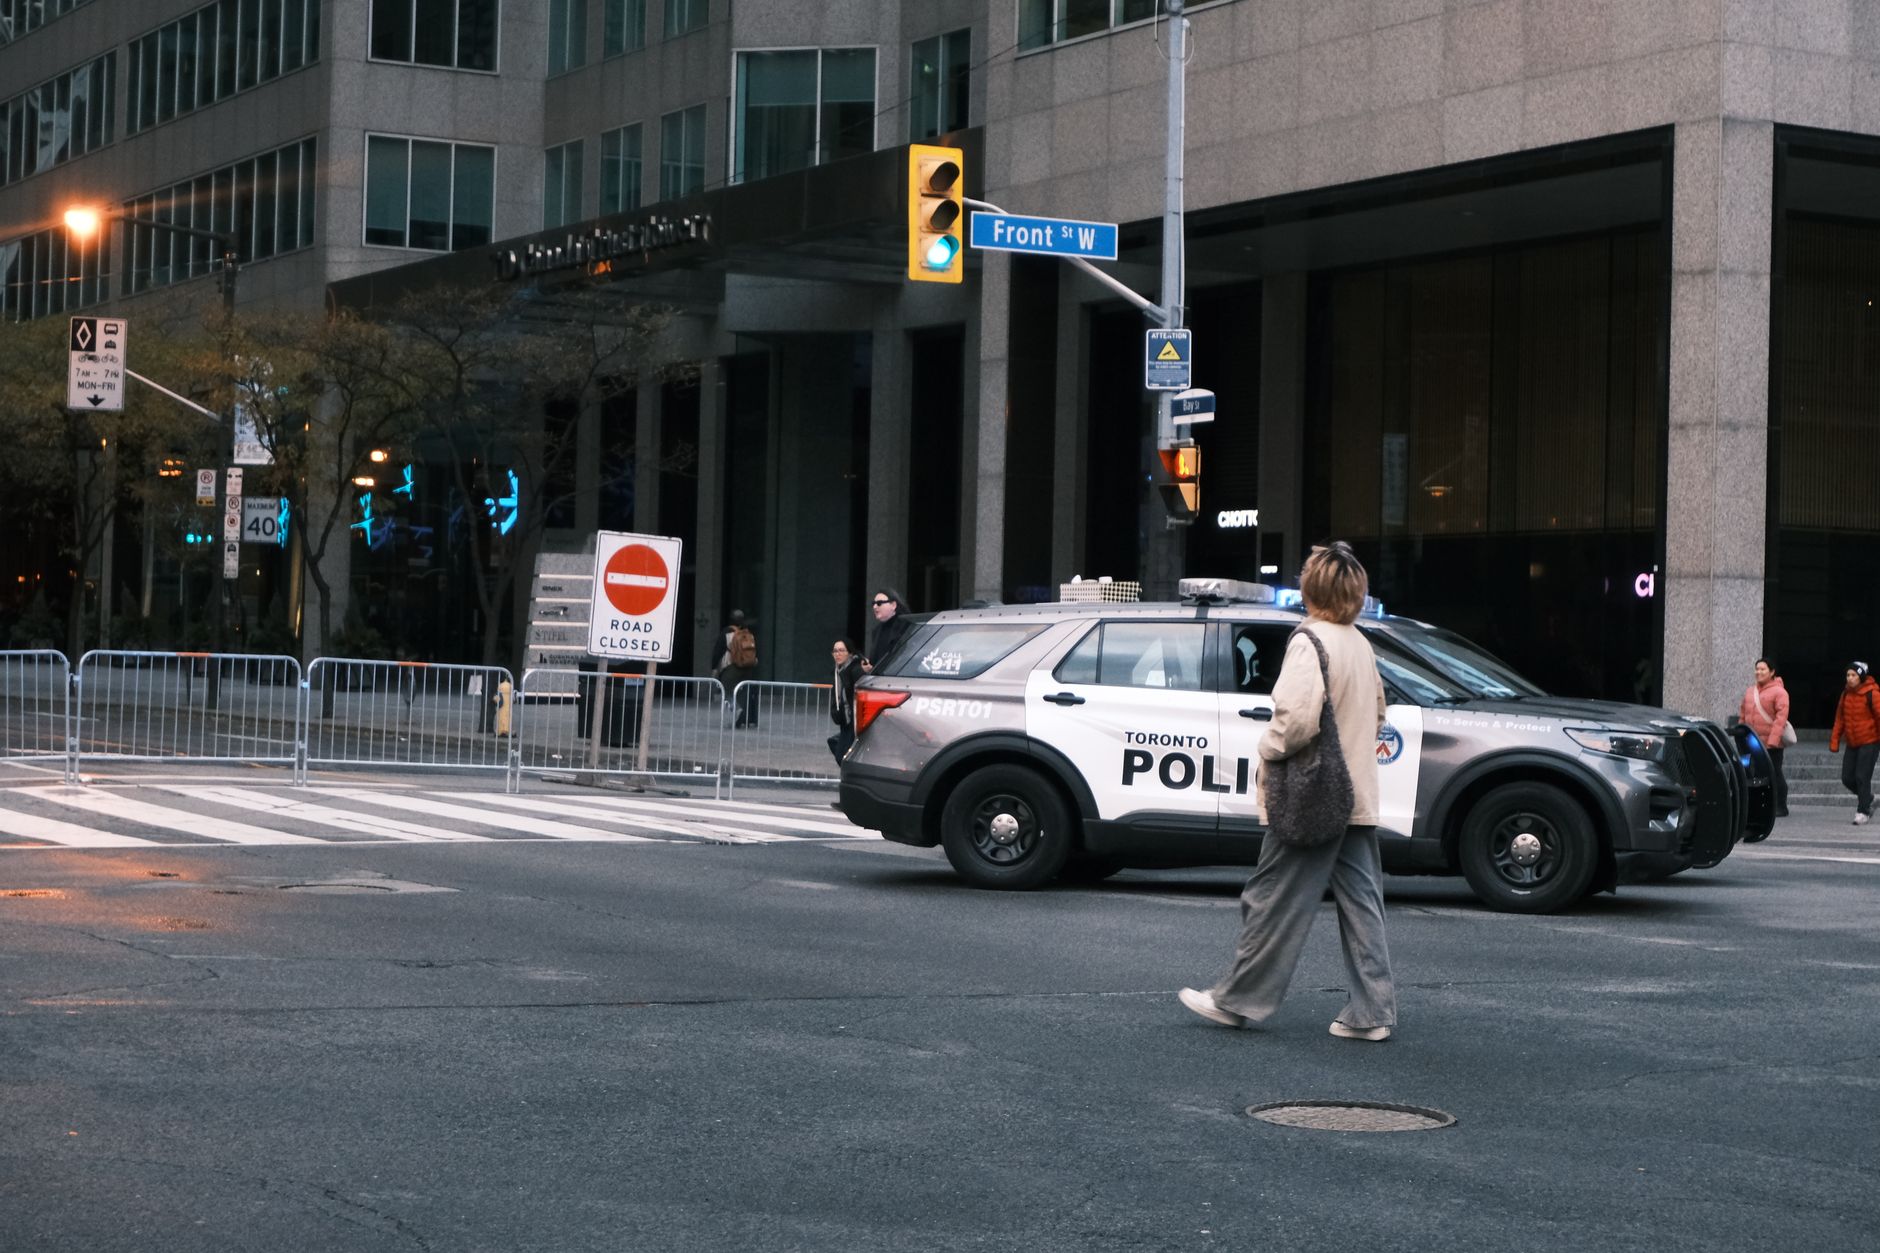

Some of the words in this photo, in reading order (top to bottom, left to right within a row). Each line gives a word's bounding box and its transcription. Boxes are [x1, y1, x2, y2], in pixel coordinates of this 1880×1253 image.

[994, 219, 1053, 248] Front
[1061, 225, 1073, 239] St
[1078, 226, 1096, 250] W
[1151, 332, 1187, 340] ATTENTION
[77, 381, 116, 391] MON-FRI
[1183, 399, 1194, 413] Bay
[247, 502, 276, 510] MAXIMUM
[247, 516, 276, 537] 40
[610, 619, 653, 633] ROAD
[600, 636, 660, 652] CLOSED
[915, 697, 993, 719] PSRT01
[1436, 716, 1450, 725] To
[1454, 717, 1489, 728] Serve
[1506, 721, 1552, 733] Protect
[1125, 731, 1208, 749] TORONTO
[1122, 748, 1257, 795] POLI
